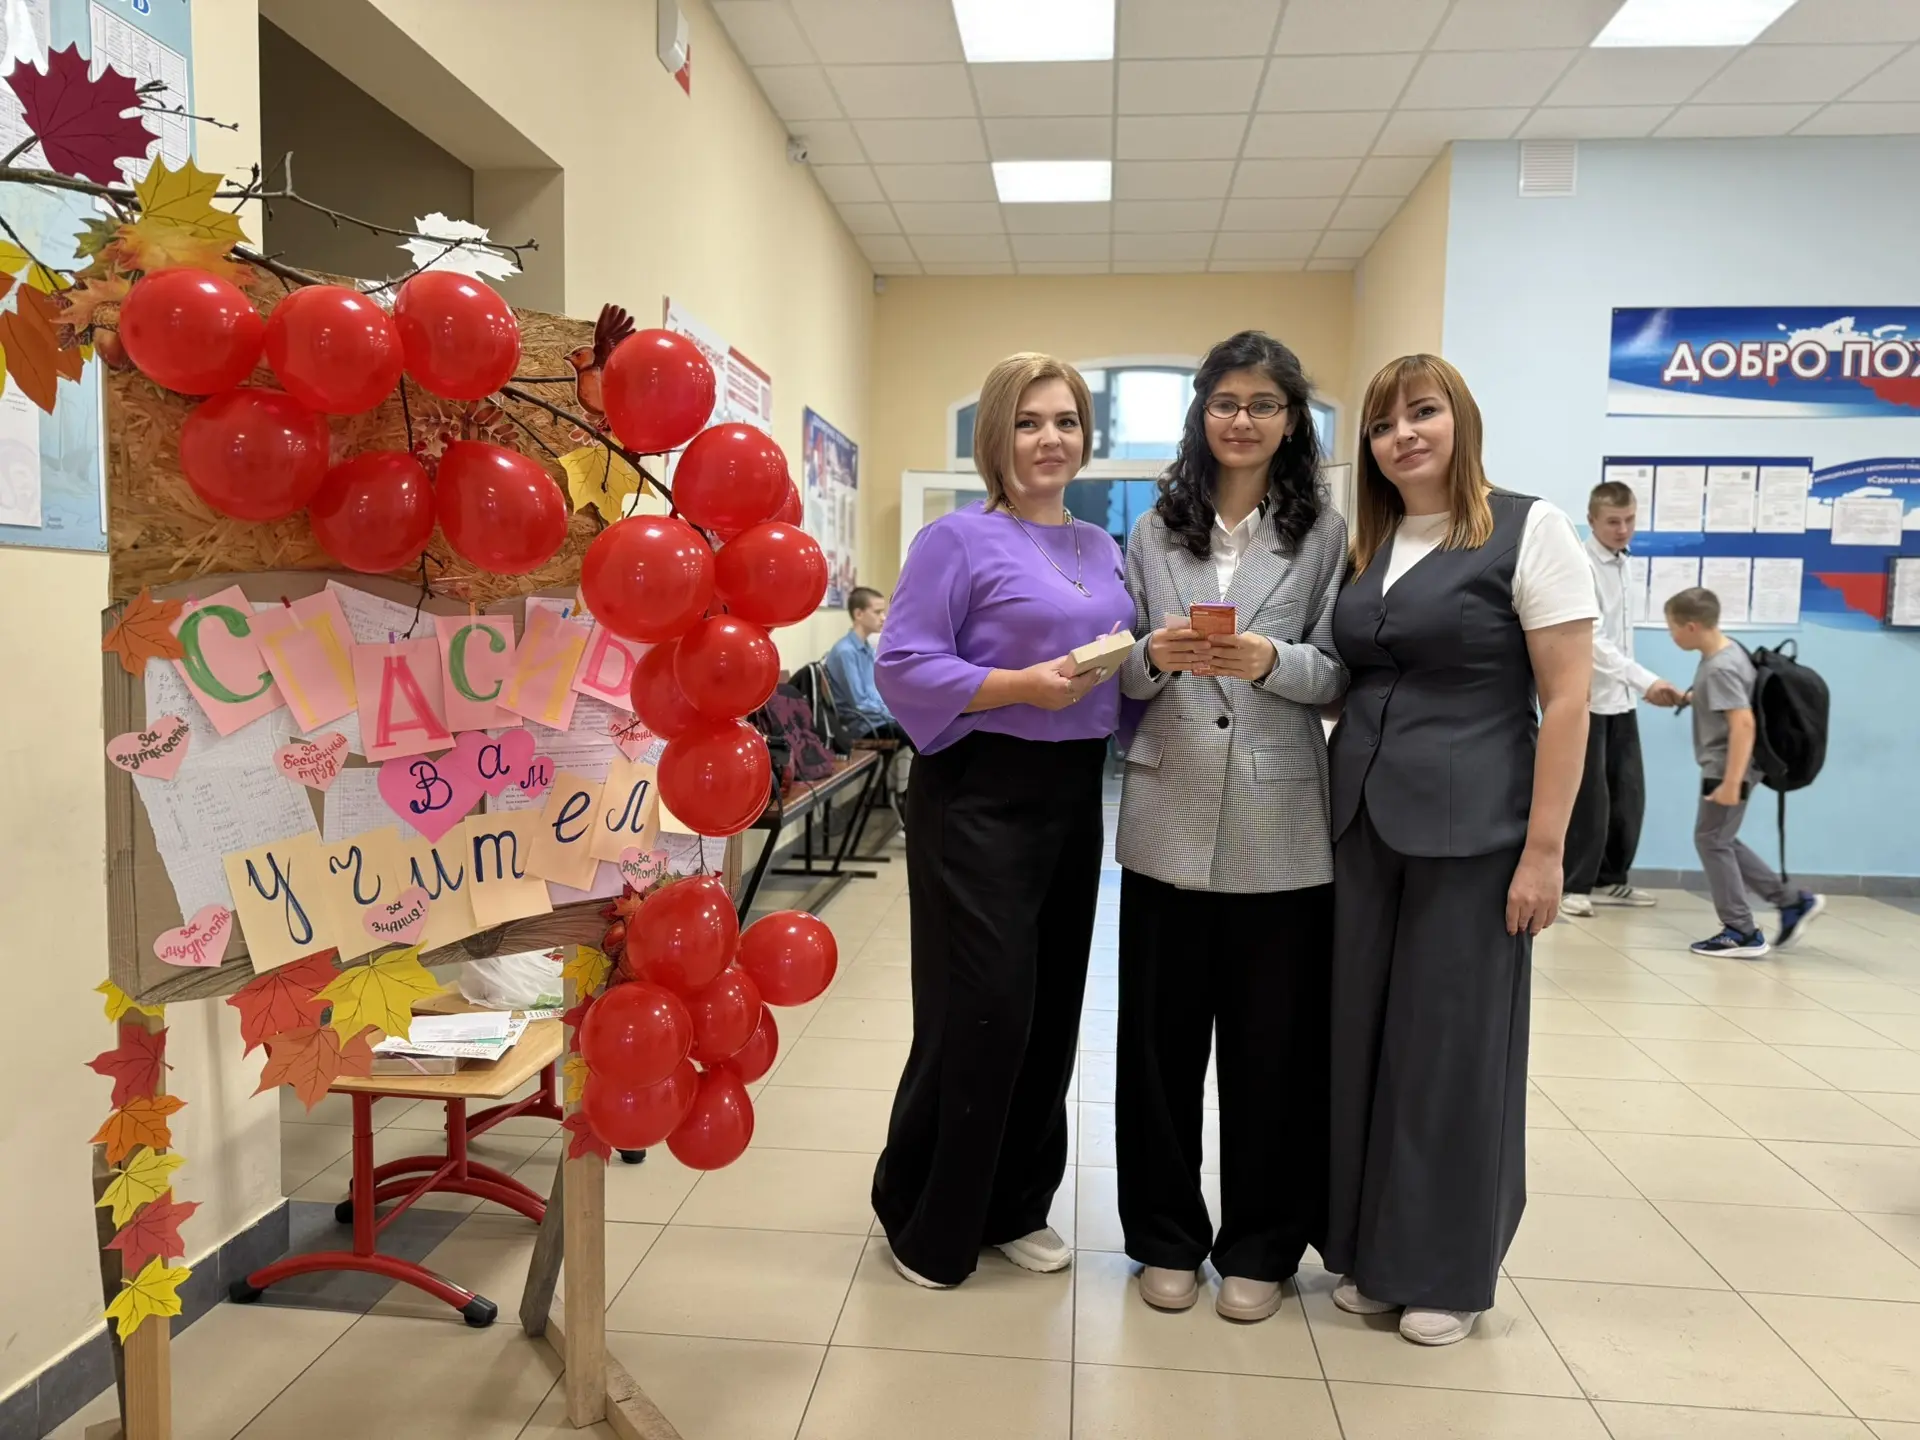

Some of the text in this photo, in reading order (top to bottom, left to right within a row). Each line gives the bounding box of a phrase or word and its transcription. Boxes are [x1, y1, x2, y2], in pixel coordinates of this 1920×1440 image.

[1663, 340, 1920, 384] ДОБРО ПО
[283, 733, 348, 769] бесценный
[298, 756, 340, 785] труд!
[622, 856, 668, 883] доброту!
[371, 900, 425, 933] знания!
